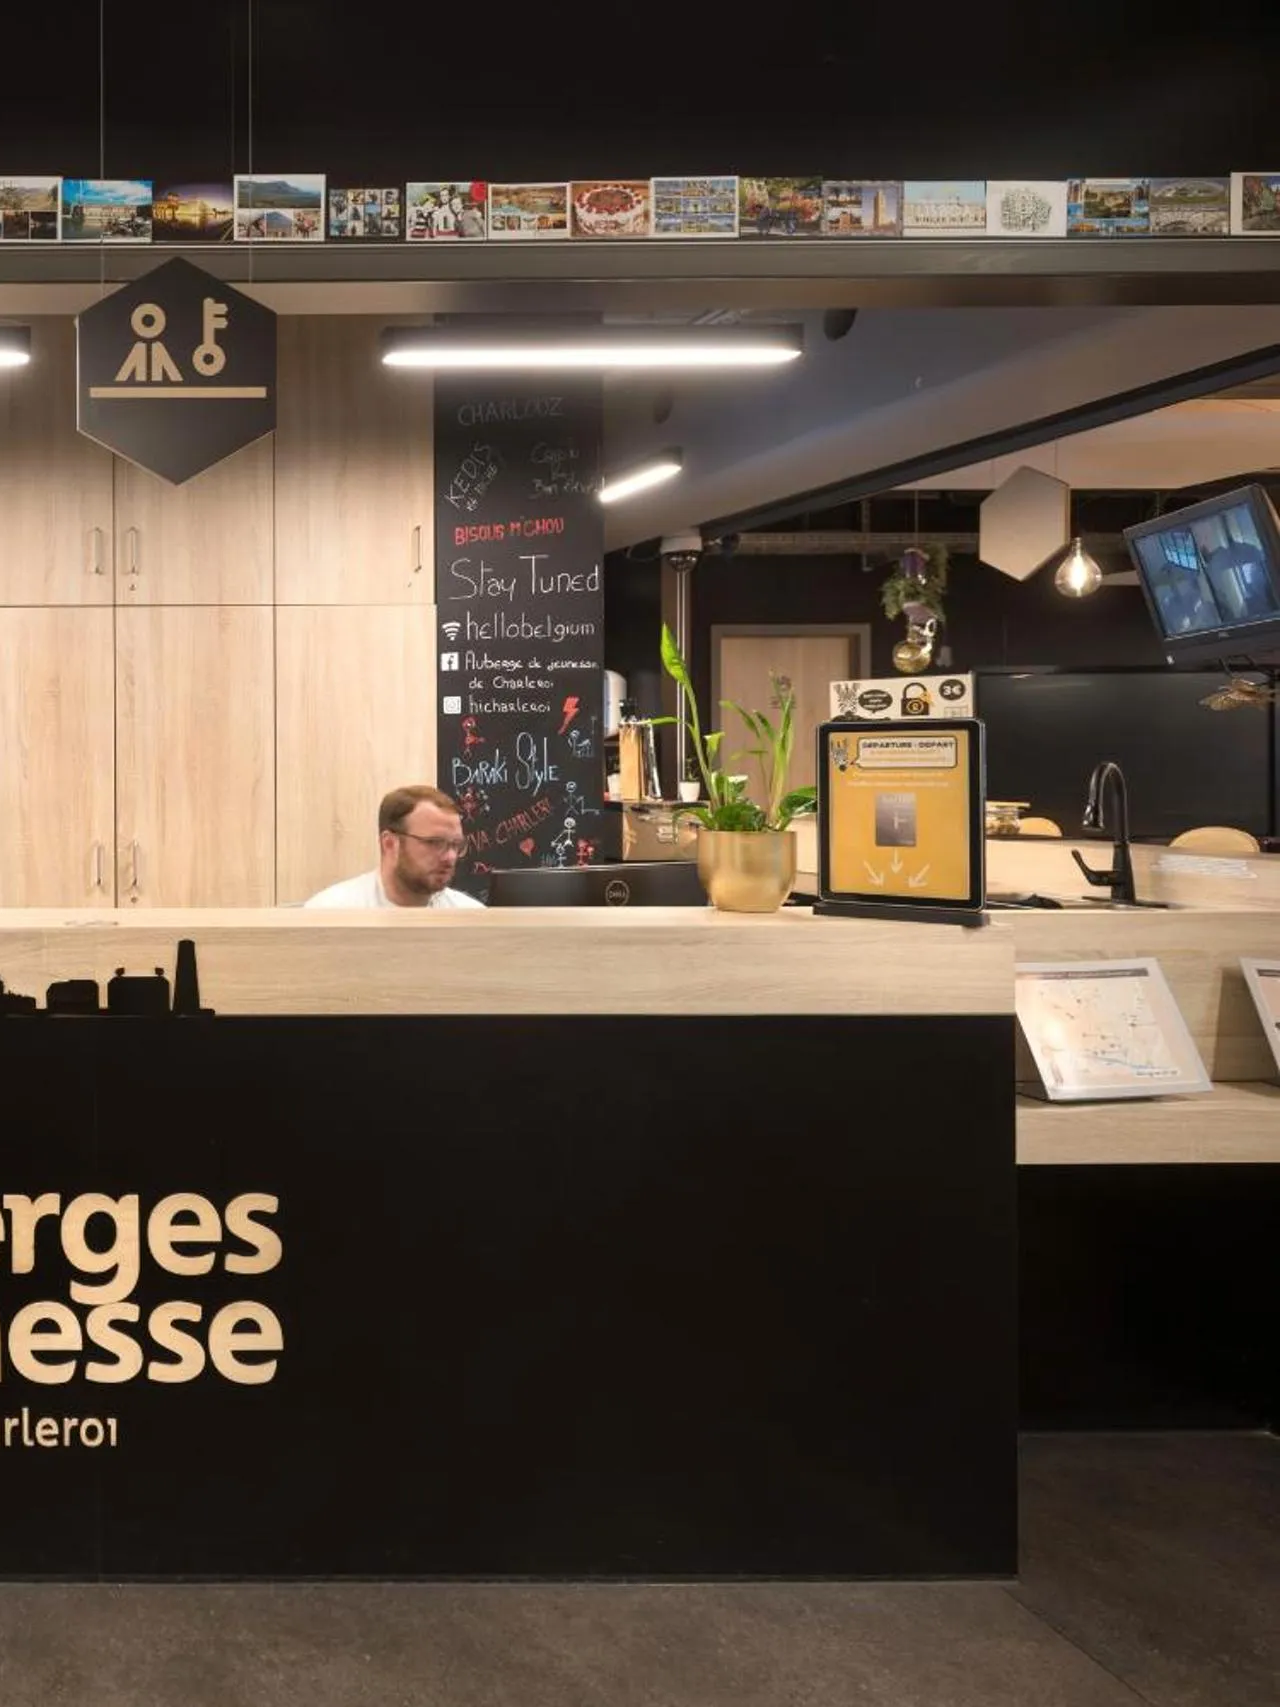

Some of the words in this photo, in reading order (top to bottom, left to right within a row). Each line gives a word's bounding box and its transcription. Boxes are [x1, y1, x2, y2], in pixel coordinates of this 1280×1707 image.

[449, 557, 517, 601] Stay
[519, 554, 600, 595] Tuned
[466, 610, 595, 642] hellobelgium
[943, 685, 961, 695] 3€
